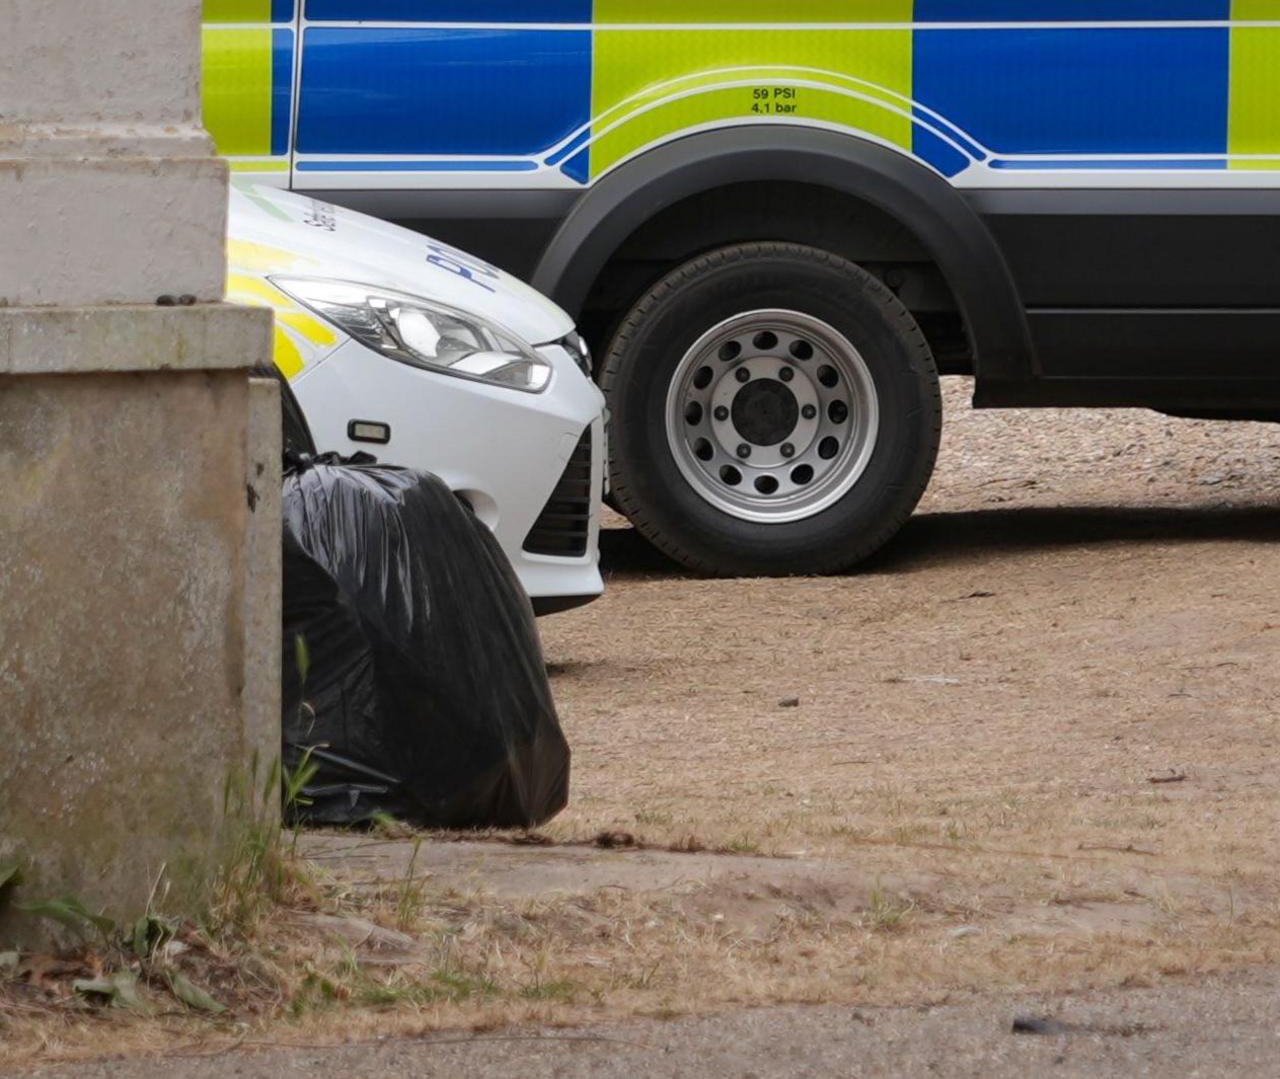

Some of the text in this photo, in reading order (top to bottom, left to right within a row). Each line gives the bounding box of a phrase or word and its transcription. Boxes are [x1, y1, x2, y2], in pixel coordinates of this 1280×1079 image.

[753, 87, 796, 100] 59 PSI
[751, 102, 797, 113] 4.1 bar
